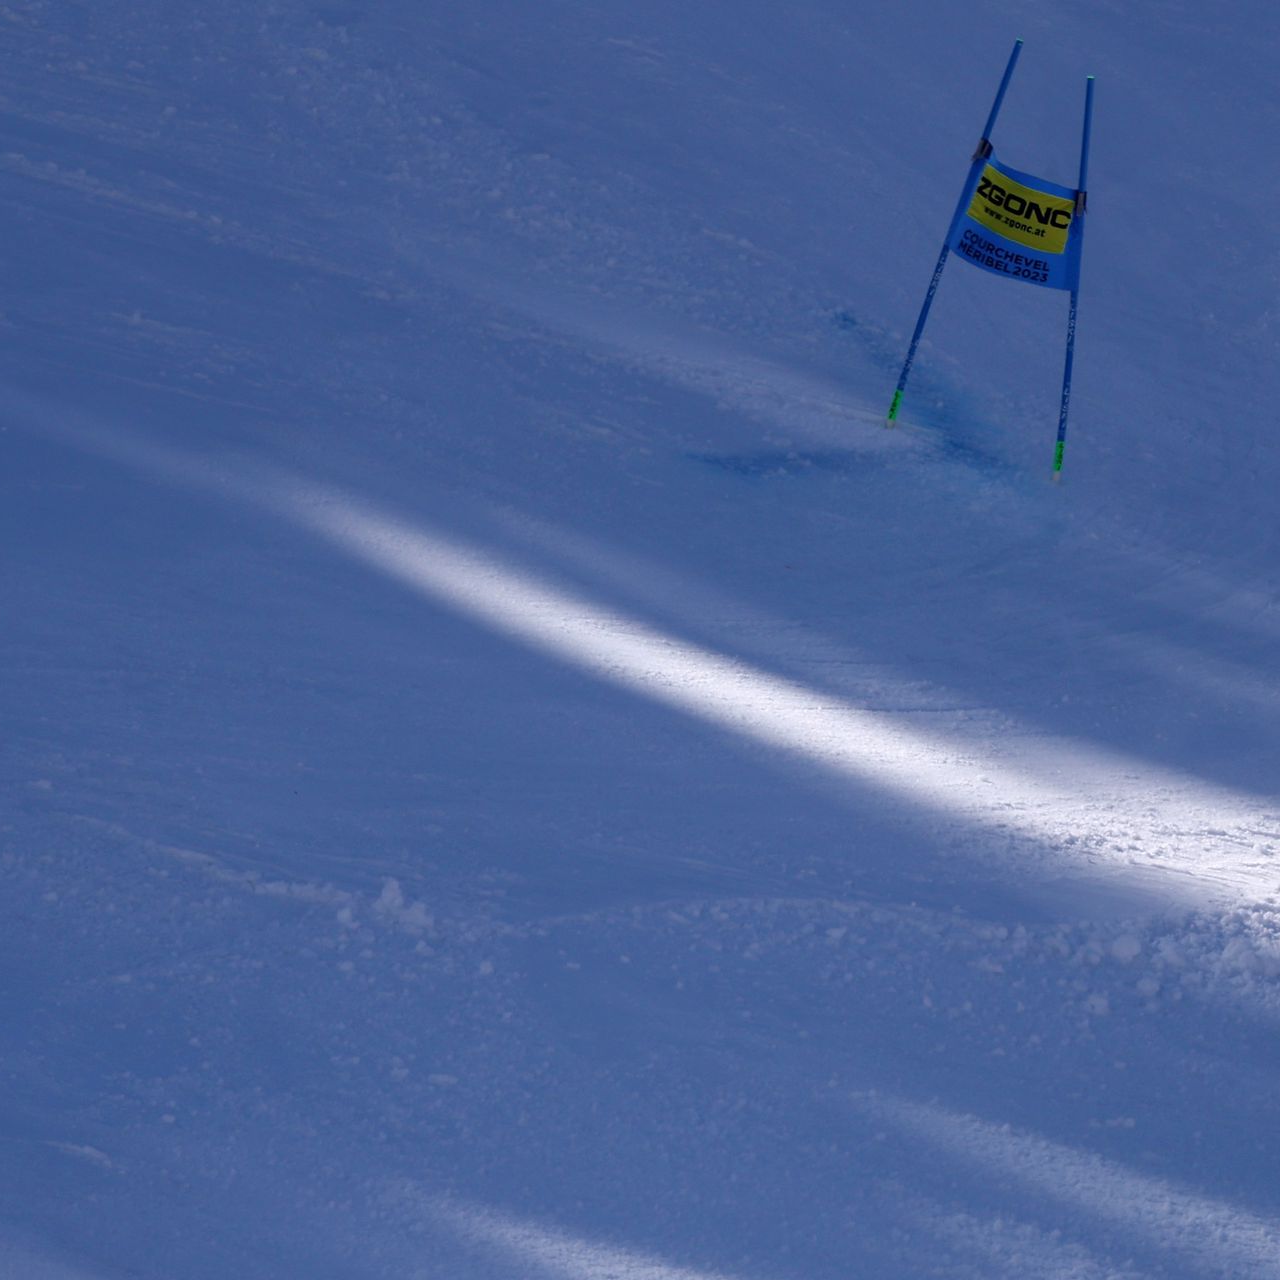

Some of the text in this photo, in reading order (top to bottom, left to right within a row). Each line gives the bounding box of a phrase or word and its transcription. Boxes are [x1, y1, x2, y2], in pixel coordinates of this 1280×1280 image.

[977, 176, 1072, 229] ZGONC
[984, 206, 1046, 238] www.zgonc.at
[963, 229, 1049, 272] COURCHEVEL
[1012, 267, 1049, 283] 2023
